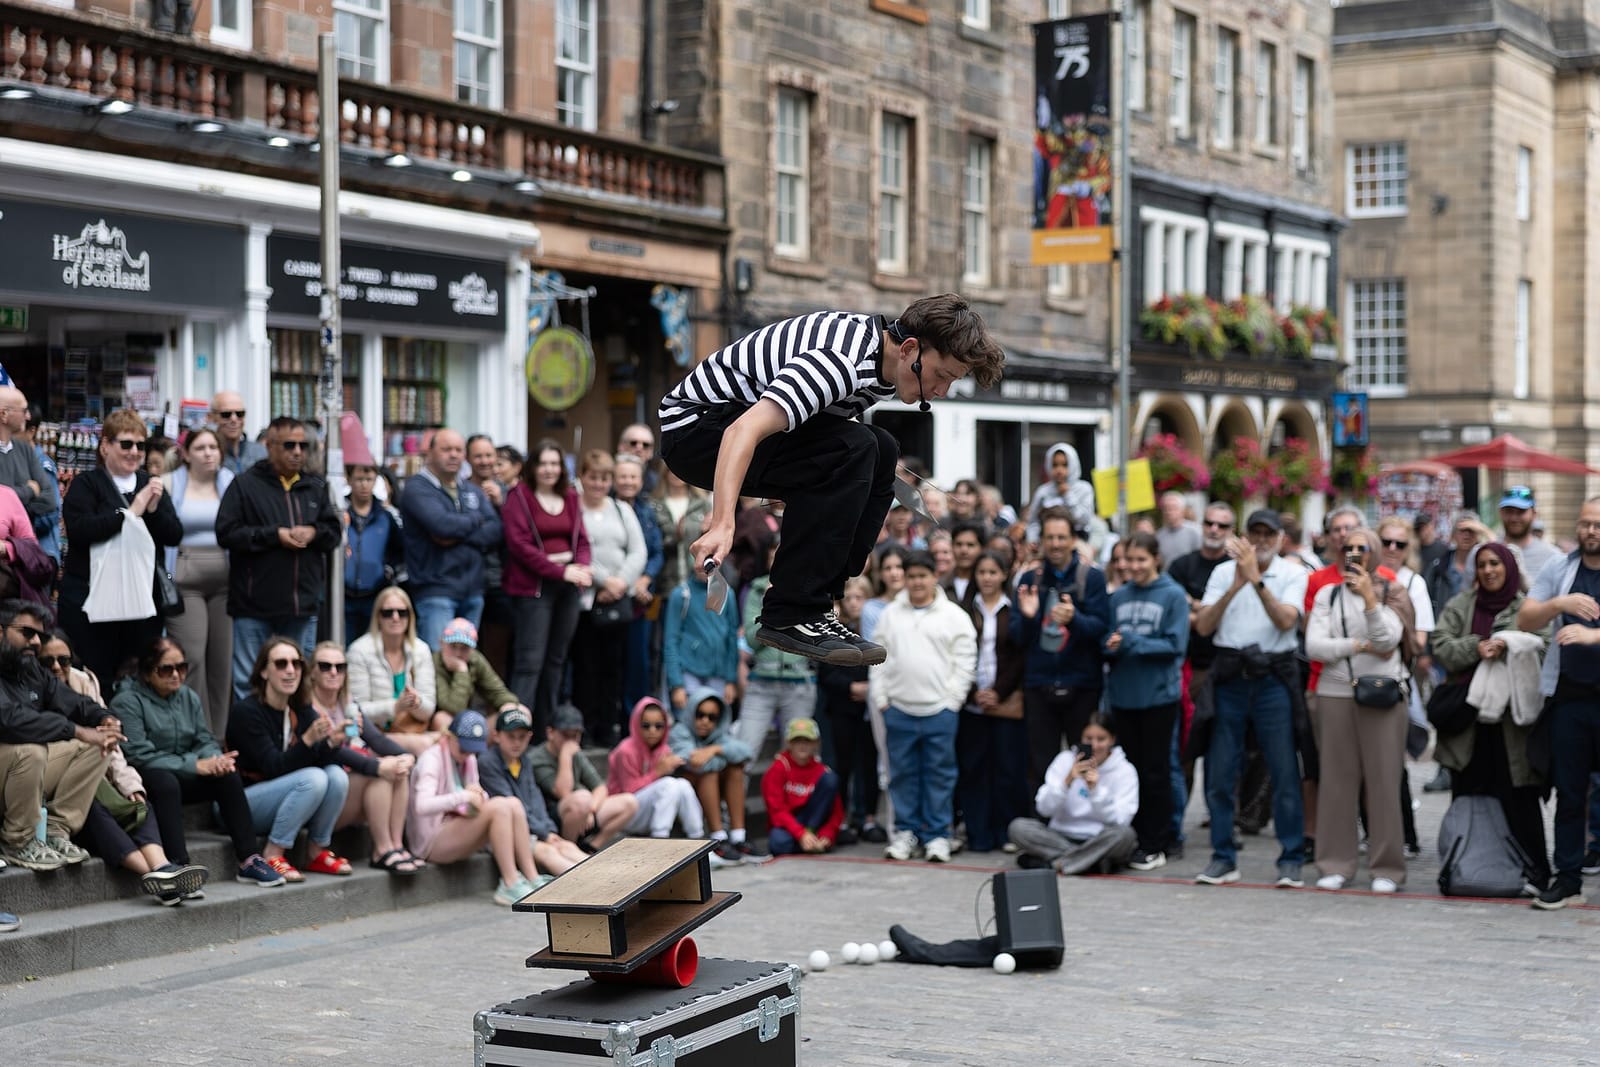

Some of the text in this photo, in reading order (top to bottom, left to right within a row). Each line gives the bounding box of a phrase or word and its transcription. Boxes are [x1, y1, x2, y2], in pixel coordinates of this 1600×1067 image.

[1053, 45, 1090, 80] 75
[52, 234, 124, 272] Heritage
[62, 259, 151, 292] of Scotland
[283, 259, 438, 291] CASHM TWEED BLANKETS
[337, 283, 358, 300] OYS
[366, 286, 419, 306] SOUVENIRS
